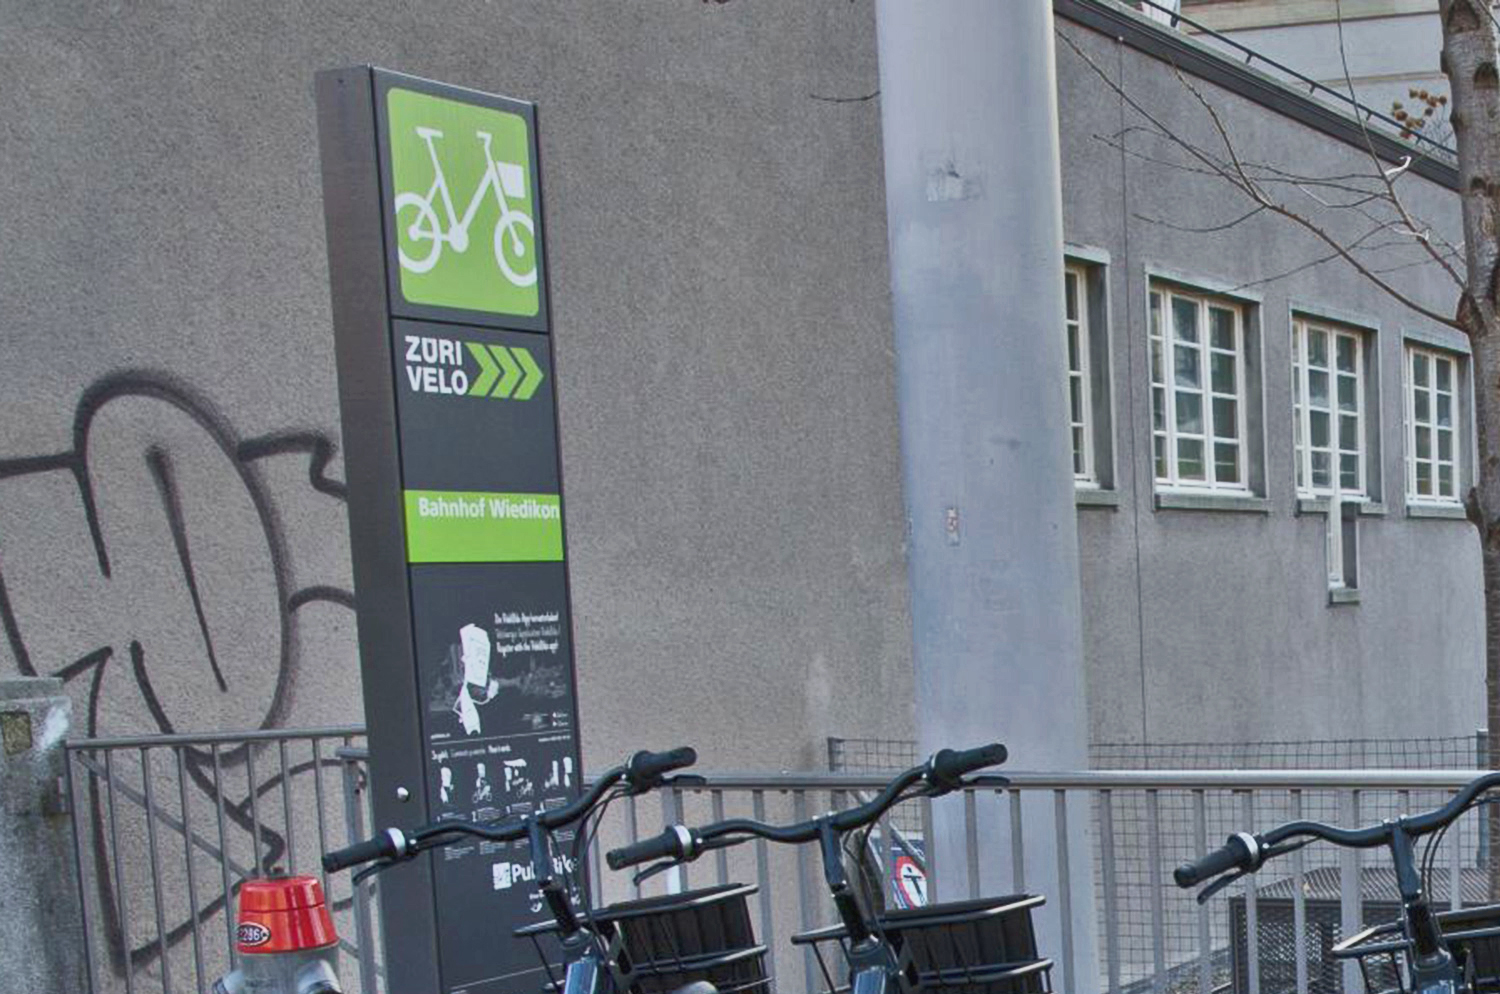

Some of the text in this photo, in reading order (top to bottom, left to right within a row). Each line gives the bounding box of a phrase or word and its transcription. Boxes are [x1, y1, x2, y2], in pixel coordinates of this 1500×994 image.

[405, 335, 462, 365] ZÜRI
[405, 366, 468, 396] VELO
[418, 496, 560, 520] Bahnhof Wiedikon
